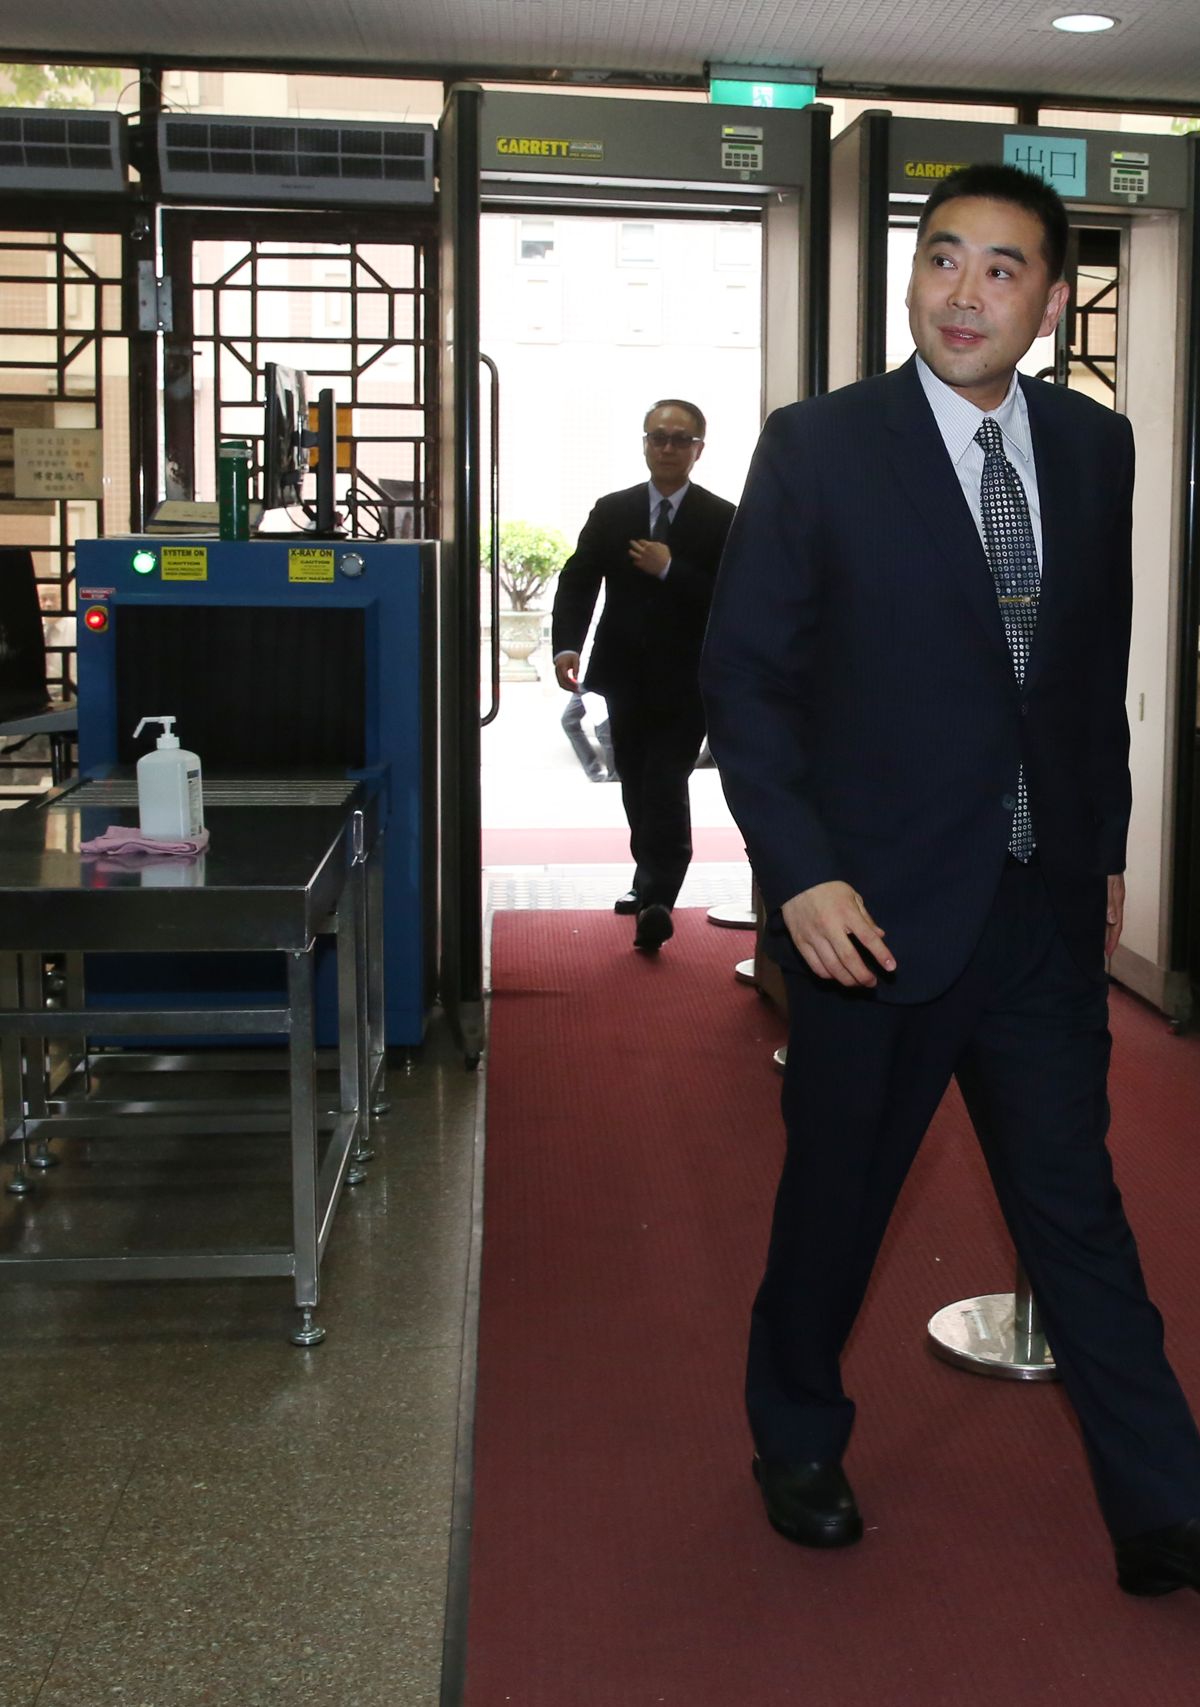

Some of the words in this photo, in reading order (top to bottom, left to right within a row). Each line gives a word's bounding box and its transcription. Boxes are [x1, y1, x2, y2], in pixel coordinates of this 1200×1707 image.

[497, 139, 569, 156] GARRETT
[905, 162, 961, 178] GARRE
[1015, 146, 1076, 188] 出口
[194, 549, 205, 557] ON
[291, 549, 316, 557] X-RAY
